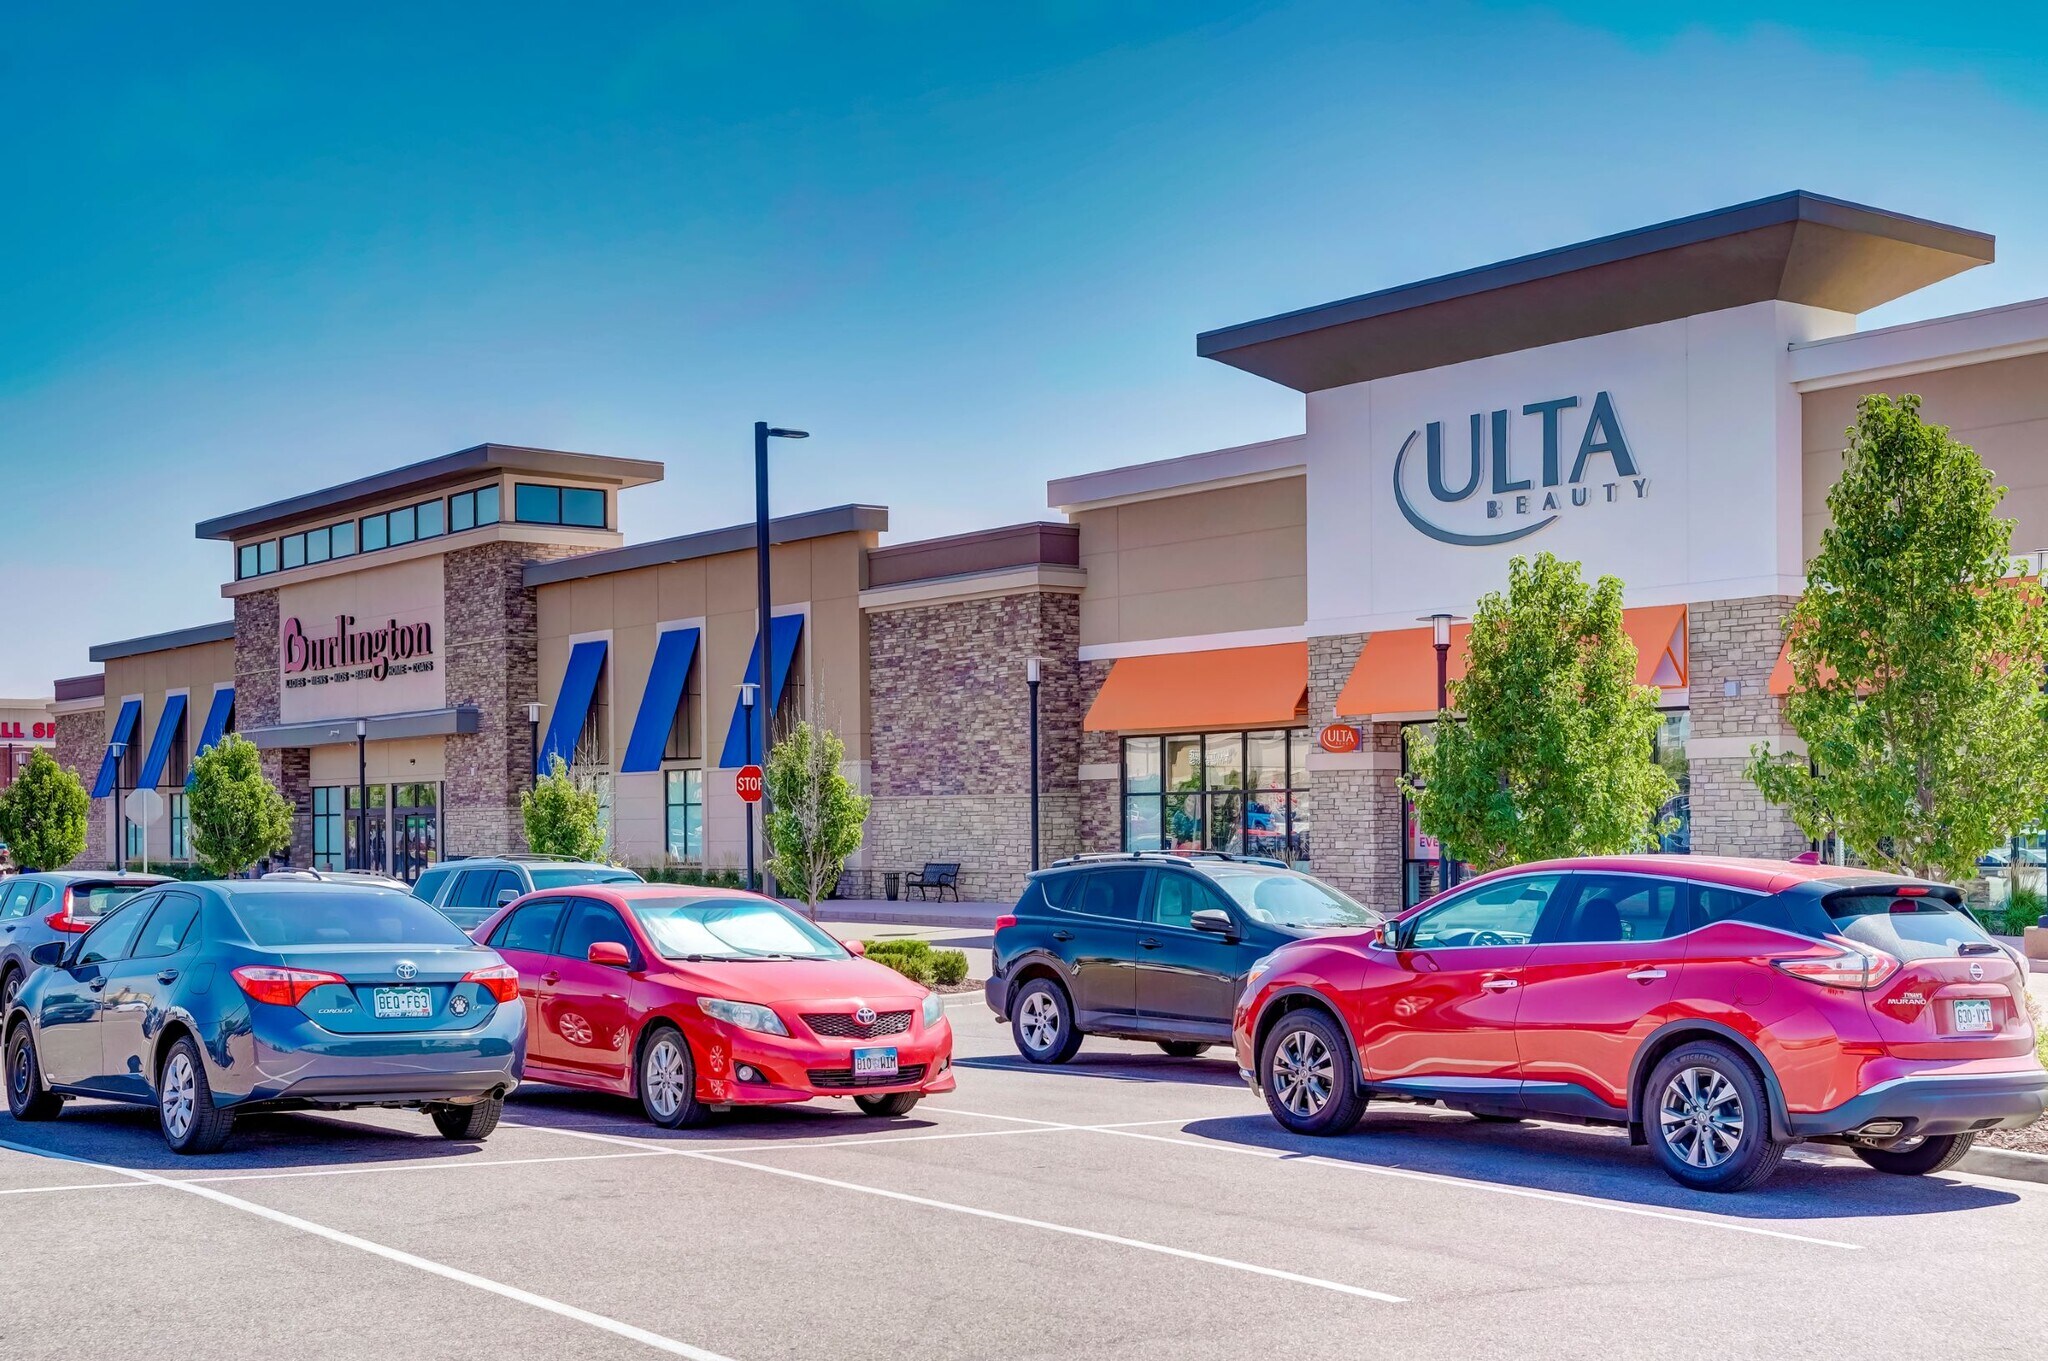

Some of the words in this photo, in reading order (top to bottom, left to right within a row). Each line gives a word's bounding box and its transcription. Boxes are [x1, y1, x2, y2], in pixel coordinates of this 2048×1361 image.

[1426, 389, 1641, 503] ULTA
[1486, 477, 1651, 519] BEAUTY
[284, 614, 434, 681] Burlington
[1327, 729, 1355, 742] ULTA
